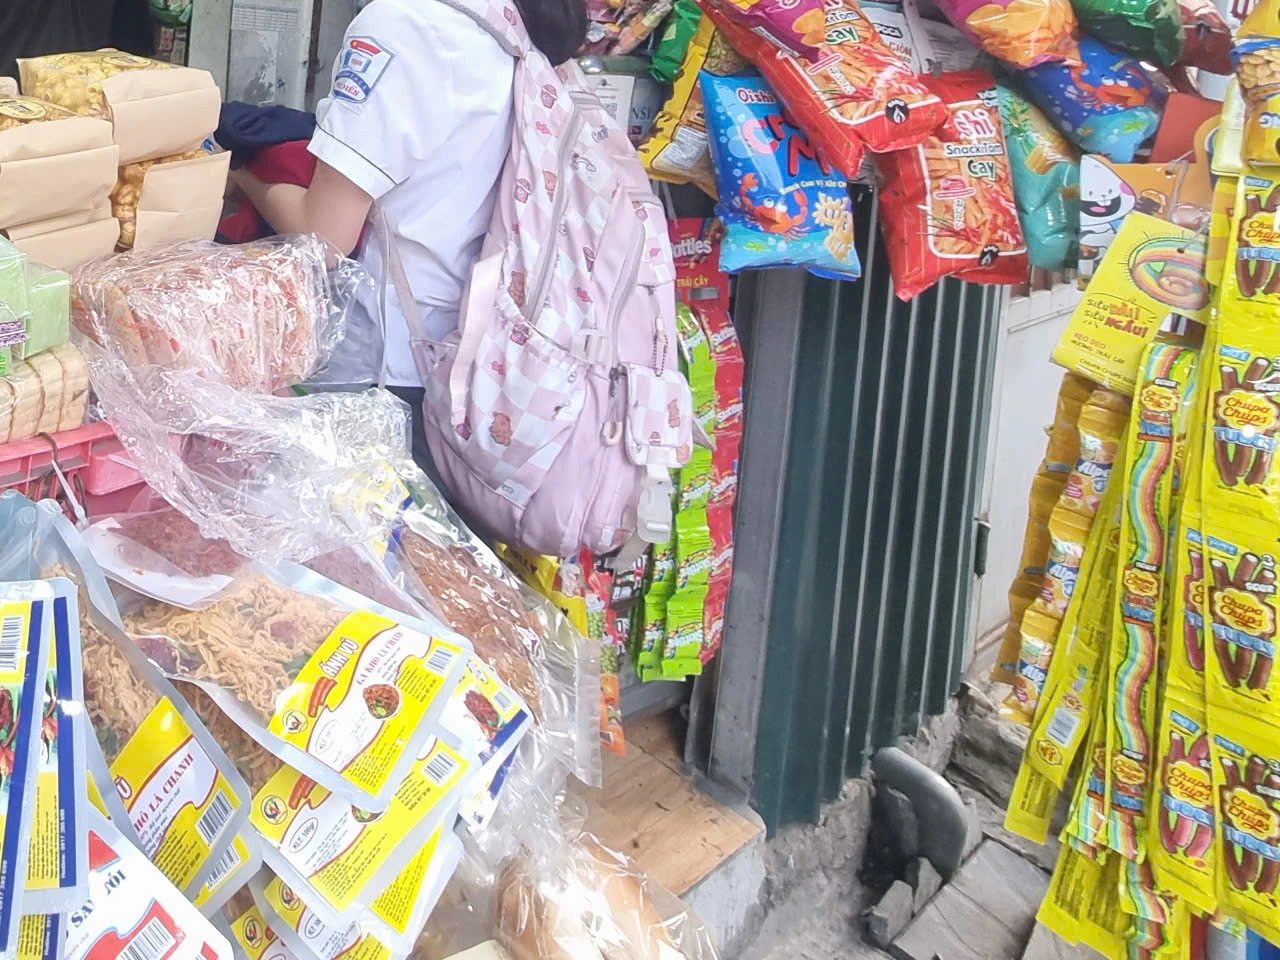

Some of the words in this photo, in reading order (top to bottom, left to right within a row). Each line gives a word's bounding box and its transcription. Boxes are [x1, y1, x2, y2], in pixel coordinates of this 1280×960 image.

[736, 87, 776, 104] Oishi
[967, 159, 995, 187] Cay
[1222, 406, 1267, 427] Chups
[1225, 396, 1271, 414] Chupa
[1220, 603, 1263, 628] Chups
[1221, 594, 1263, 616] Chupa
[320, 651, 343, 678] ÁNH
[338, 635, 359, 658] VŨ
[162, 752, 196, 796] CHANH
[1170, 767, 1212, 791] Chupa
[1167, 776, 1209, 800] Chups
[1228, 805, 1270, 833] Chups
[1230, 795, 1271, 821] Chupa
